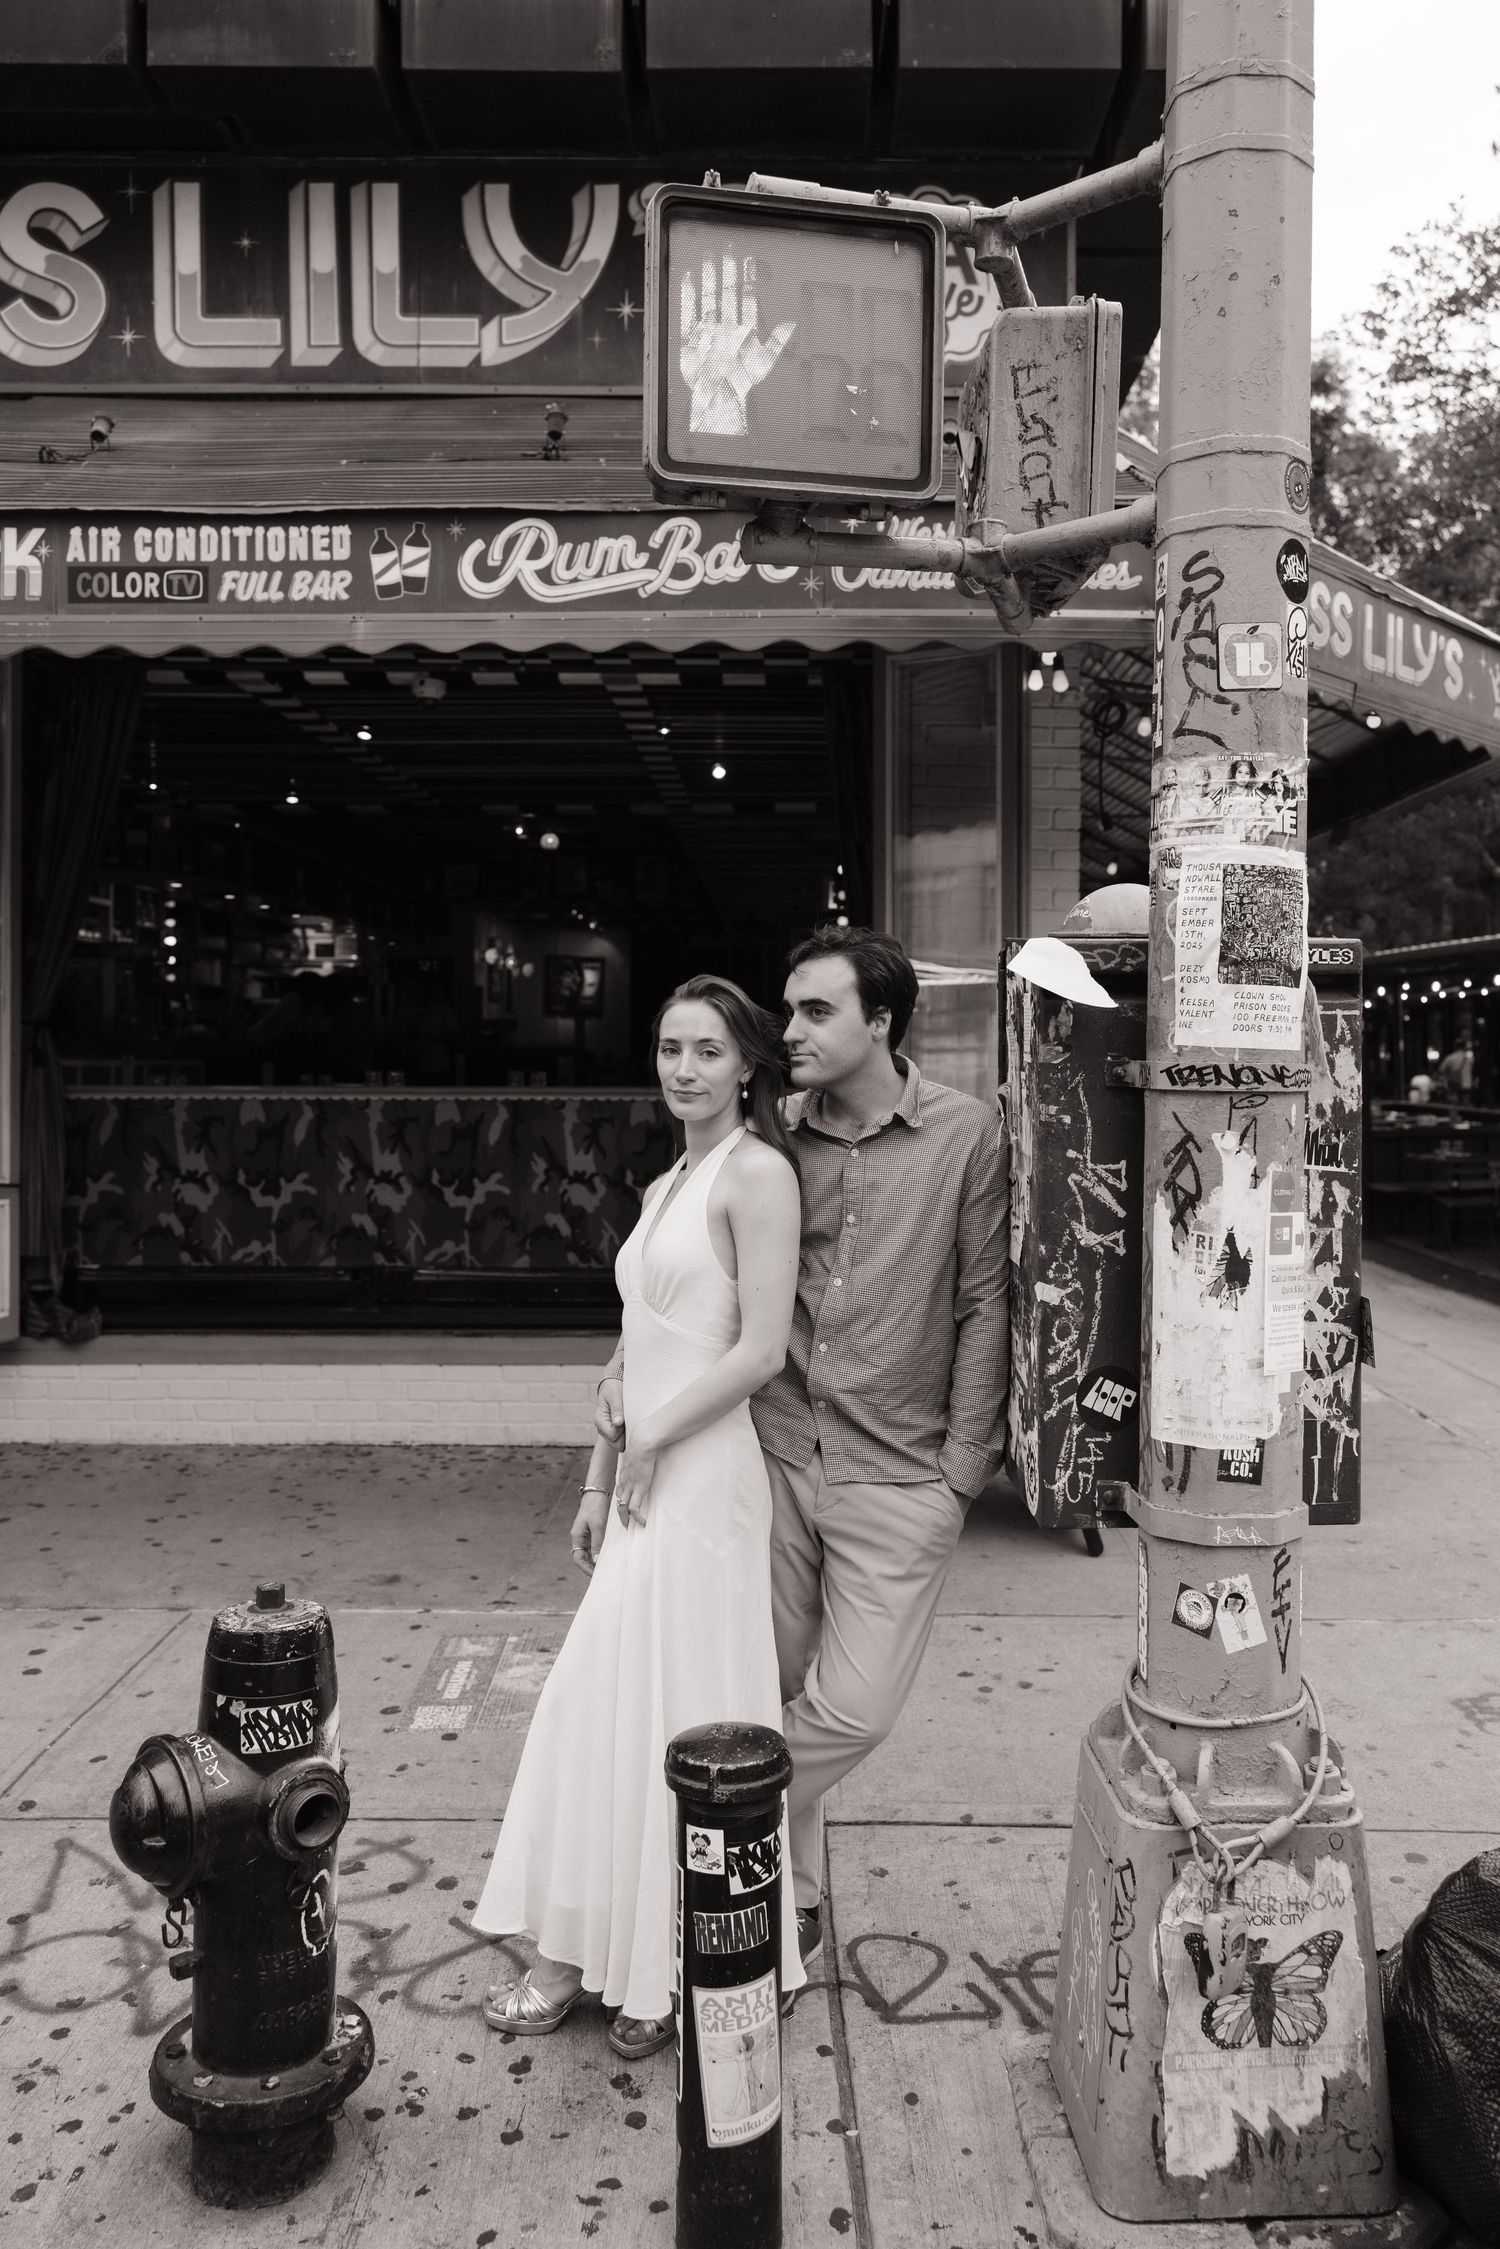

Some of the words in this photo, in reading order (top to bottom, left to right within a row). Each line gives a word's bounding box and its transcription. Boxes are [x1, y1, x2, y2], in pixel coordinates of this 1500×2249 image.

[152, 179, 660, 367] LILY'
[66, 525, 122, 562] AIR
[134, 524, 352, 562] CONDITIONED
[457, 517, 661, 603] Rum
[638, 516, 800, 598] Ba
[76, 571, 160, 598] COLOR
[168, 574, 198, 595] TV
[217, 570, 284, 603] FULL
[289, 569, 353, 601] BAR
[1362, 603, 1465, 700] LILY'S
[1186, 862, 1221, 872] THOUSA
[1185, 873, 1221, 883] NDWALL
[1183, 885, 1216, 894] STARE
[1182, 907, 1208, 916] SEPT
[1181, 919, 1215, 928] EMBER
[1180, 941, 1203, 950] 2025
[1179, 964, 1205, 973] DEZY
[1179, 975, 1210, 984] KOSMO
[1234, 991, 1265, 1000] CLOWN
[1179, 997, 1215, 1008] KELSEA
[1233, 1002, 1267, 1011] PRISON
[1179, 1009, 1215, 1019] VALENT
[1232, 1013, 1249, 1021] 100
[1178, 1021, 1193, 1029] INE
[1232, 1023, 1263, 1033] DOORS
[1081, 1376, 1137, 1421] LOOP
[1229, 1461, 1253, 1478] CO.
[1246, 1914, 1277, 1927] YORK
[1280, 1913, 1305, 1926] CITY
[694, 1903, 769, 1954] REMAND
[701, 1979, 773, 2010] ANTI
[701, 1994, 774, 2021] SOCIAL
[702, 2005, 774, 2034] MEDIA
[714, 2101, 780, 2139] omniku.com
